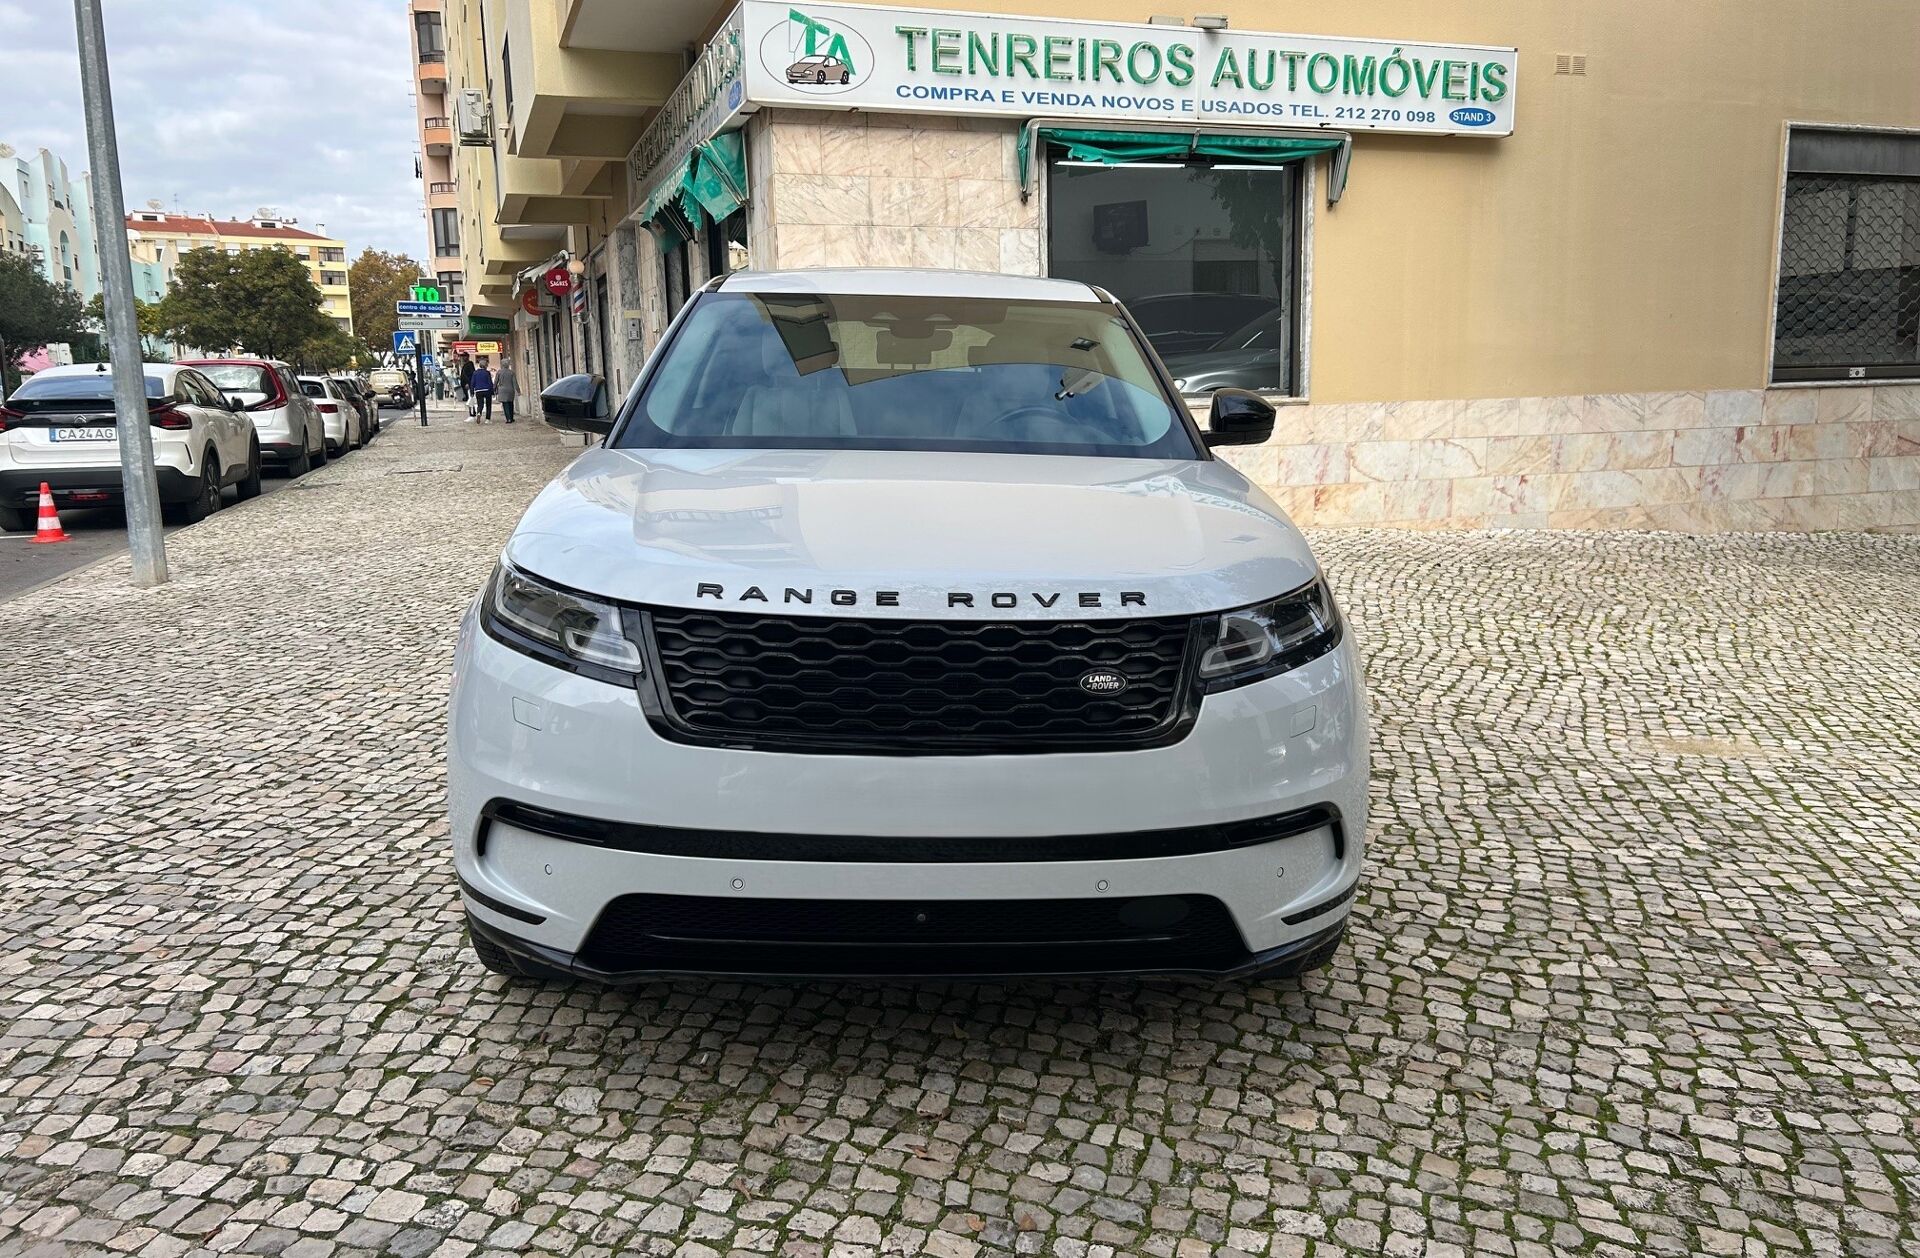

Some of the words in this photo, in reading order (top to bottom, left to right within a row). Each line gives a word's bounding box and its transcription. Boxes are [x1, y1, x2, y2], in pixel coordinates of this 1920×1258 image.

[895, 25, 1195, 86] TENREIROS
[1210, 47, 1508, 102] AUTOMÓVEIS
[896, 84, 996, 103] COMPRA
[1001, 90, 1016, 103] E
[1021, 91, 1096, 107] VENDA
[1102, 96, 1175, 111] NOVOS
[1181, 99, 1194, 112] E
[1201, 99, 1284, 116] USADOS
[1289, 104, 1330, 118] TEL.
[1335, 106, 1366, 120] 212
[1371, 108, 1401, 122] 270
[1406, 111, 1436, 123] 098
[1452, 111, 1485, 123] STAND
[1486, 113, 1493, 123] 3
[428, 304, 446, 312] saúde
[58, 429, 77, 439] CA
[79, 429, 93, 438] 24
[95, 429, 113, 438] AG
[697, 582, 900, 606] RANGE
[947, 591, 1148, 609] ROVER
